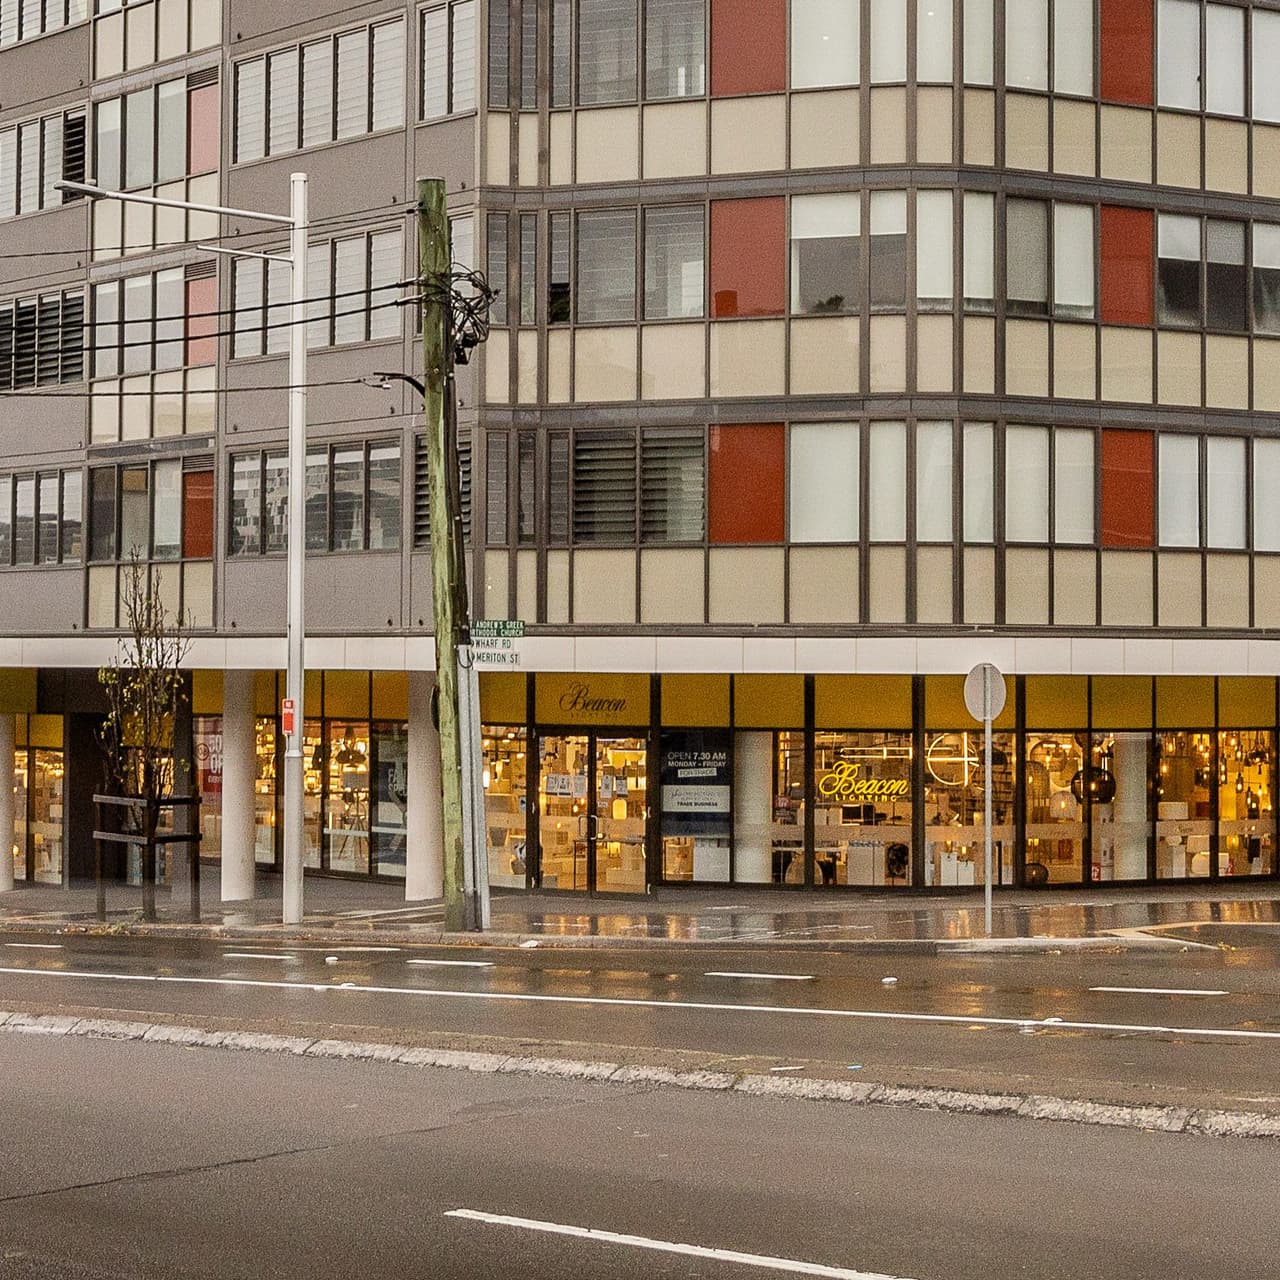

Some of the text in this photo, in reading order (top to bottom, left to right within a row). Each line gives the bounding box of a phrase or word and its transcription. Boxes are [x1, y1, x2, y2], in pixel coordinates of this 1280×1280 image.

[476, 639, 511, 649] WHARF RD
[477, 652, 518, 664] MERITON ST
[559, 680, 627, 712] Beacon
[667, 751, 726, 760] OPEN 7.30 AM
[819, 761, 909, 795] Beacon
[835, 794, 897, 802] LIGHTING
